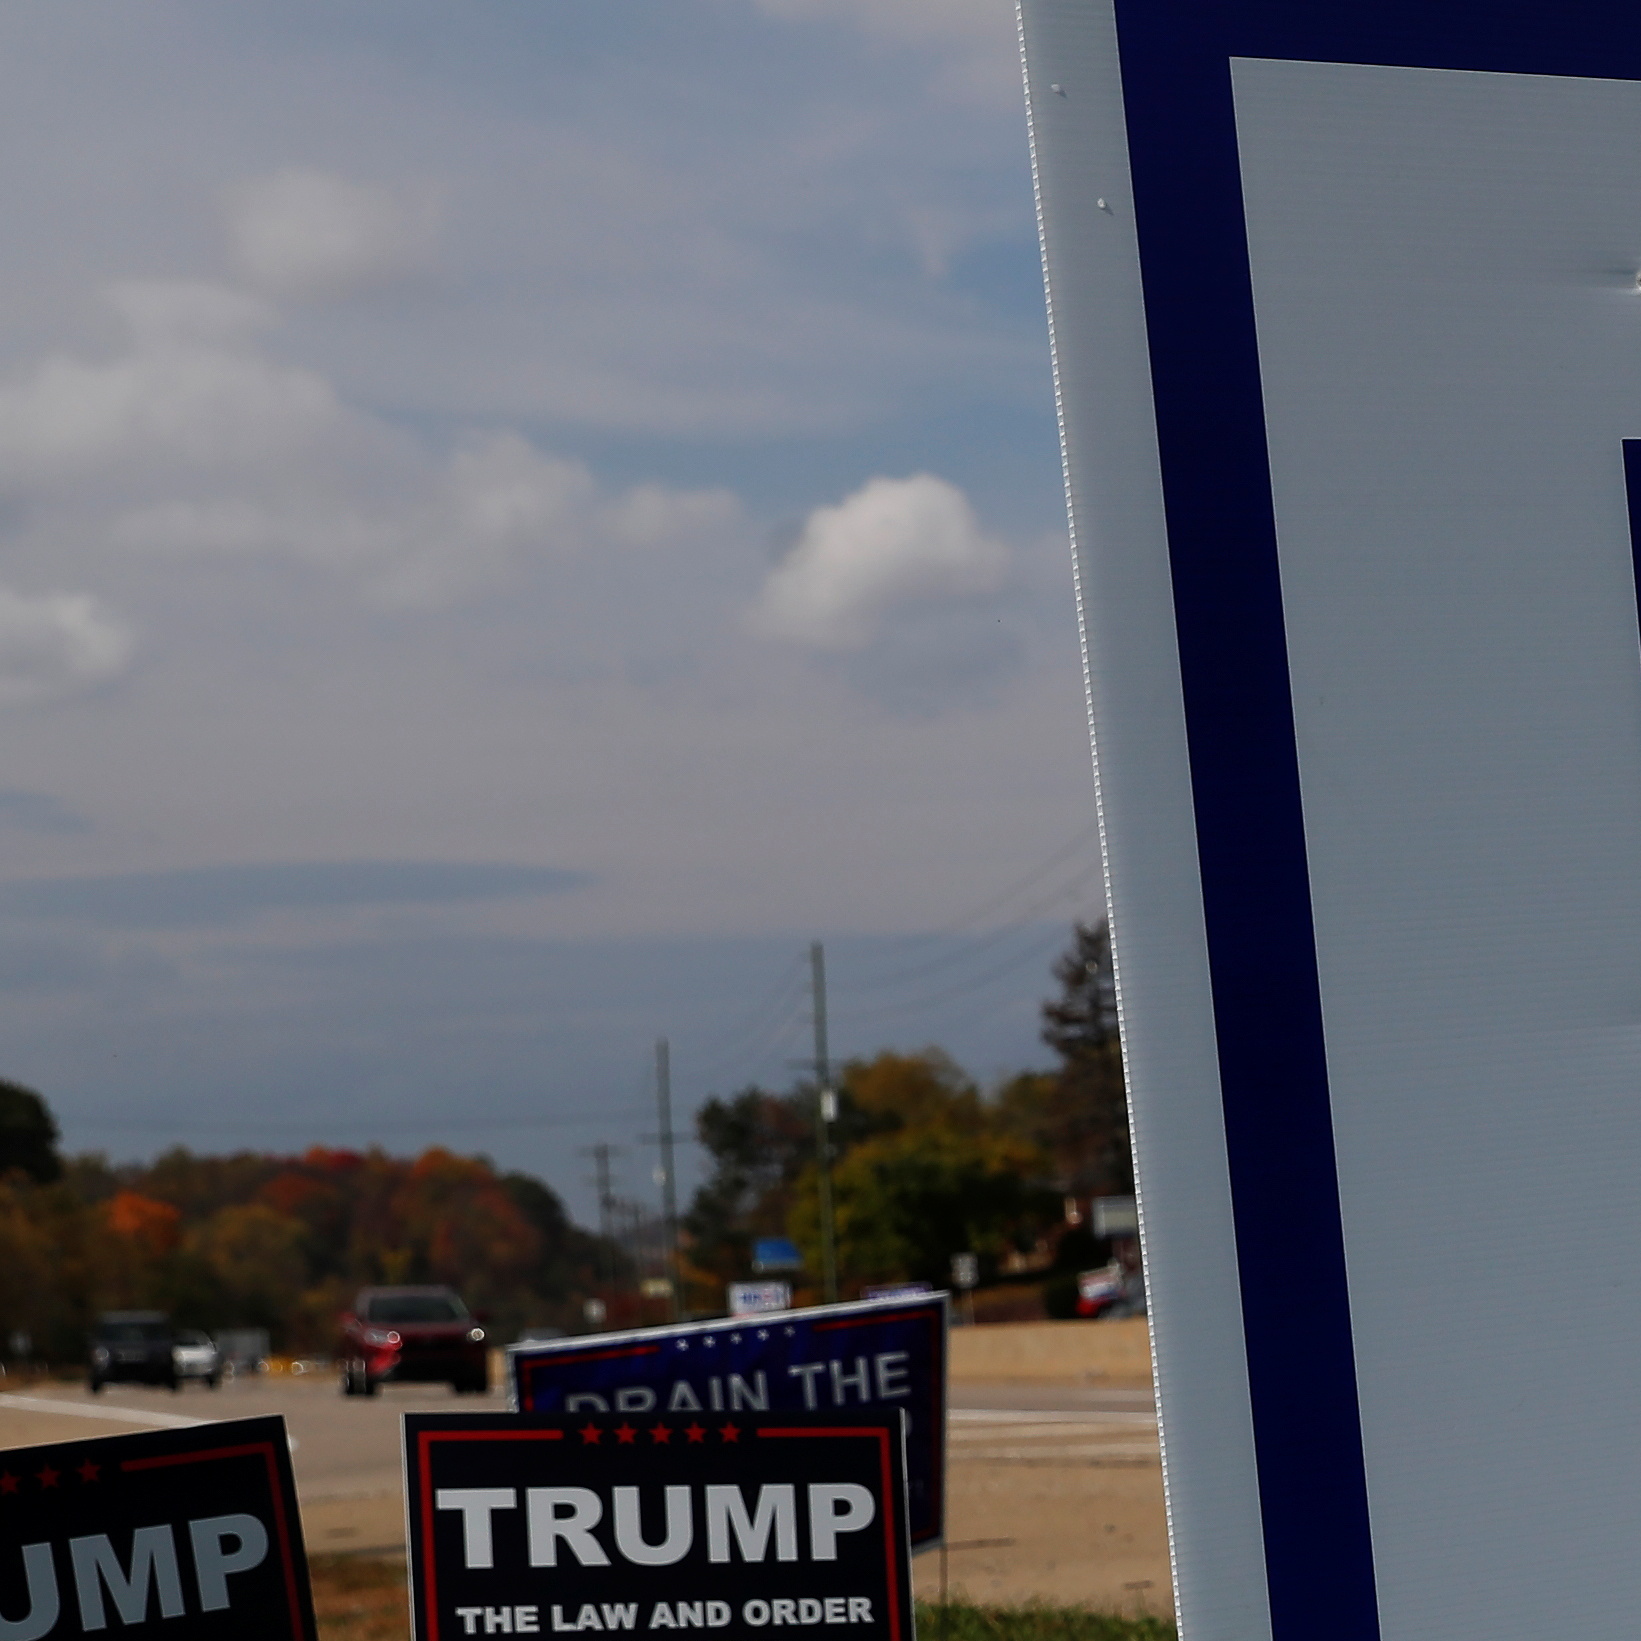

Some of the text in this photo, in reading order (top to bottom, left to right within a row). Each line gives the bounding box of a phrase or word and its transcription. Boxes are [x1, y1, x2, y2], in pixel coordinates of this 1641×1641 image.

[787, 1350, 911, 1411] THE
[435, 1482, 876, 1570] TRUMP
[455, 1596, 875, 1634] THE LAW AND ORDER
